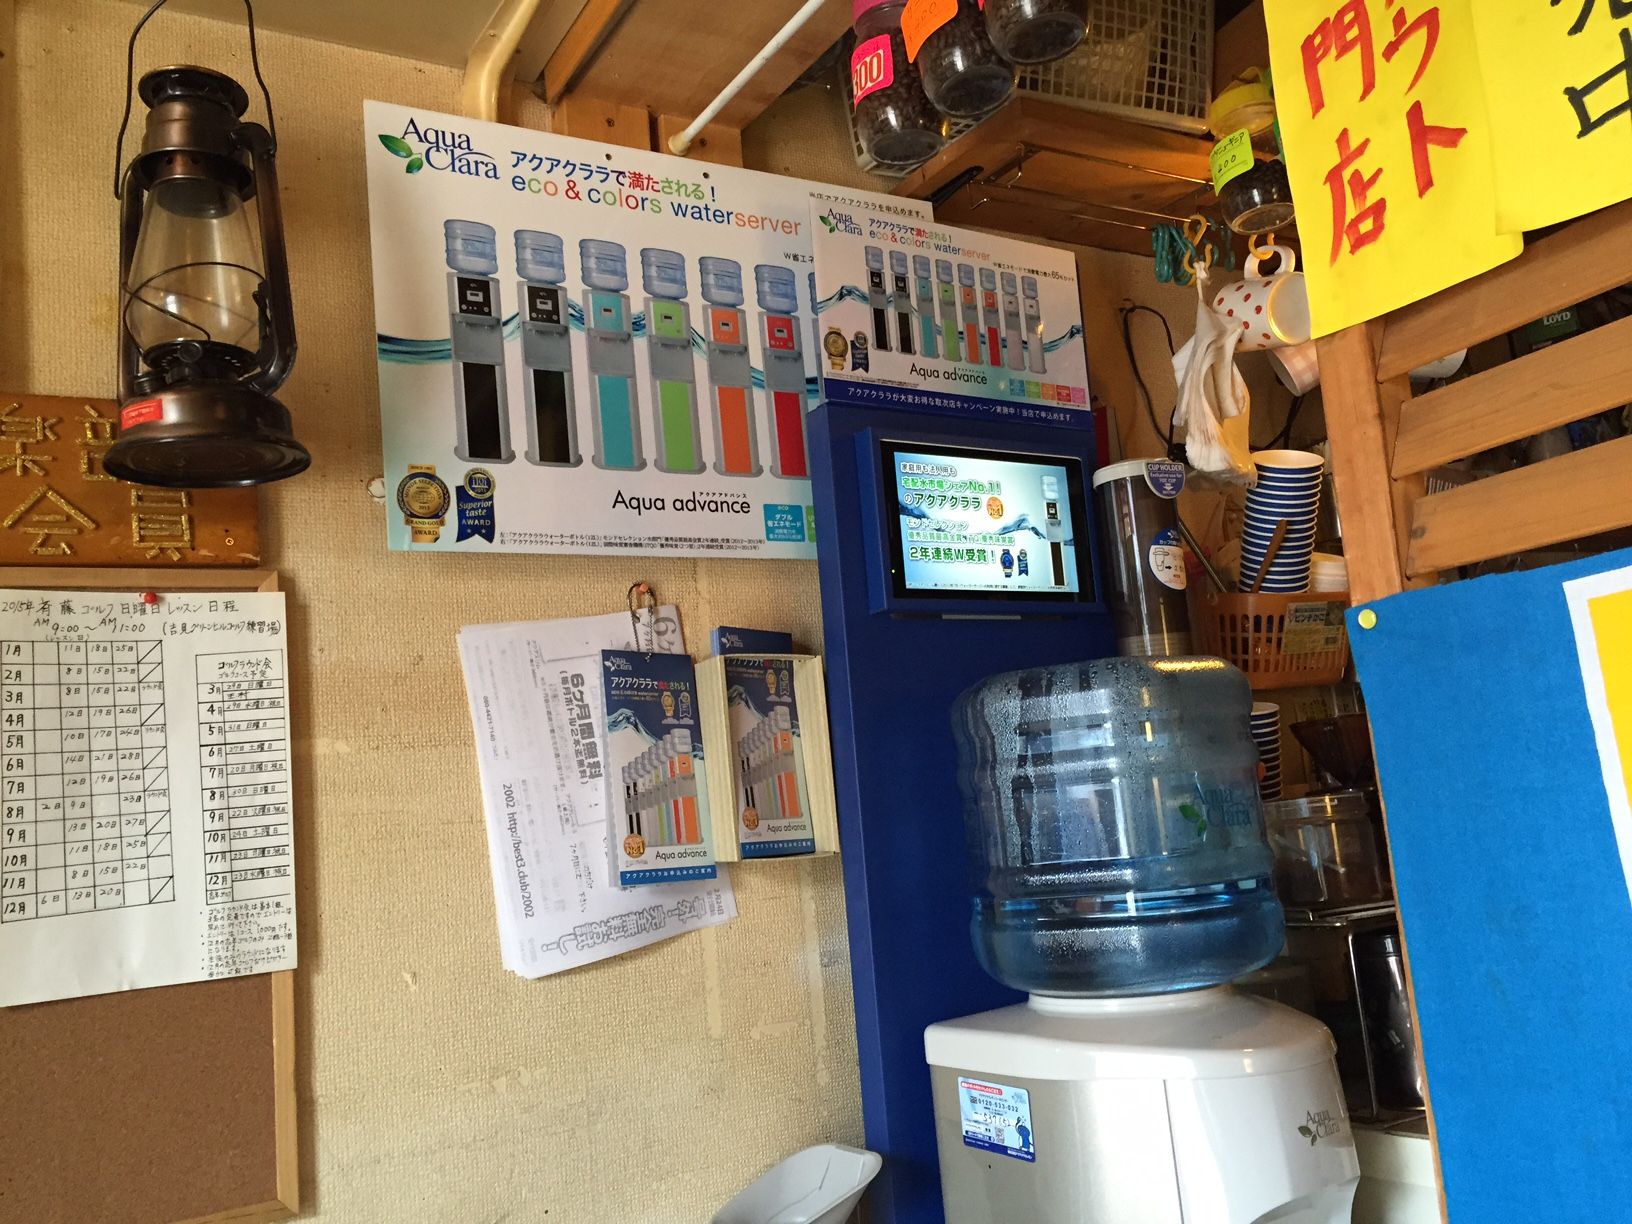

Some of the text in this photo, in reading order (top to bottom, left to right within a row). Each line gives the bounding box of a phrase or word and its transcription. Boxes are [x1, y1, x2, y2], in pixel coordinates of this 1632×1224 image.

[401, 117, 473, 150] Aqua
[425, 146, 500, 179] Clara
[512, 174, 801, 236] eco & colors waterserver
[827, 208, 853, 224] Aqua
[835, 221, 863, 236] Clara
[870, 230, 991, 261] eco & colors waterserver
[910, 363, 940, 381] Aqua
[942, 366, 987, 385] advance
[612, 490, 751, 516] Aqua advance
[466, 509, 487, 517] taste
[5, 644, 21, 656] 1月
[5, 670, 22, 681] 2月
[5, 691, 23, 704] 3月
[6, 714, 23, 727] 4月
[6, 735, 23, 748] 5月
[7, 758, 23, 771] 6月
[7, 781, 24, 794] 7月
[503, 783, 516, 808] 2002
[7, 806, 23, 818] 8月
[767, 822, 807, 835] Aqua advance
[7, 828, 26, 844] 9月
[5, 854, 27, 866] 10月
[655, 848, 707, 862] Aqua advance
[507, 812, 535, 918] http://best3.club/2002
[3, 877, 25, 889] 11月
[4, 902, 25, 915] 12月
[1306, 1110, 1331, 1125] Aqua
